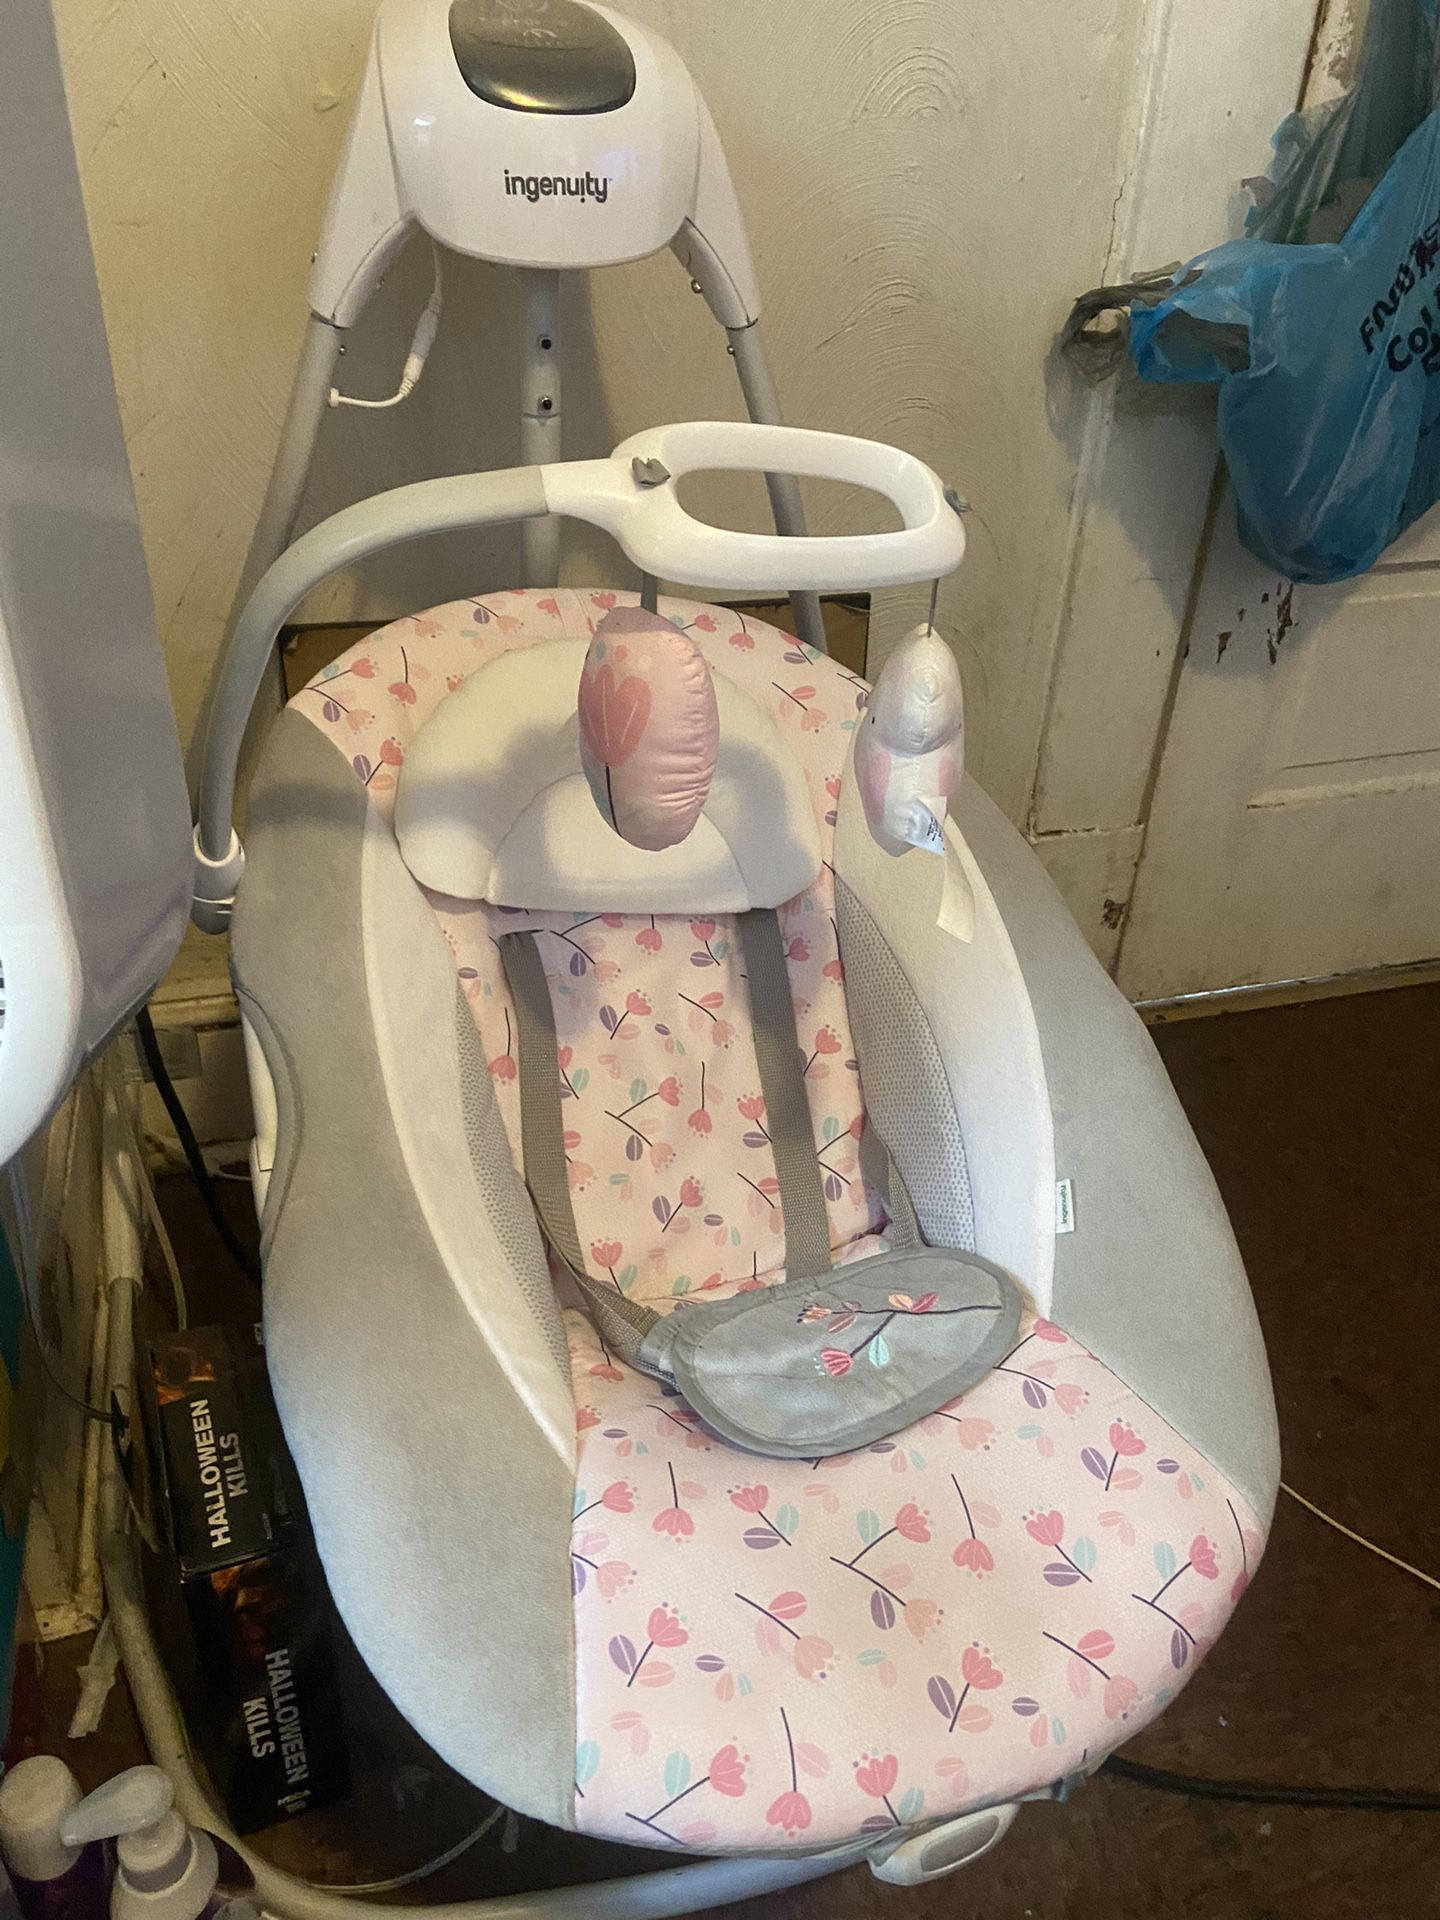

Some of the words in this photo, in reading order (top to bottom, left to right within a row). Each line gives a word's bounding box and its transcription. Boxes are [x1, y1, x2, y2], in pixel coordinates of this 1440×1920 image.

[503, 168, 609, 203] ingenuity
[190, 1399, 232, 1549] HALLOWEEN
[219, 1432, 249, 1498] KILLS
[242, 1697, 276, 1759] KILLS
[265, 1648, 312, 1784] HALLOWEEN
